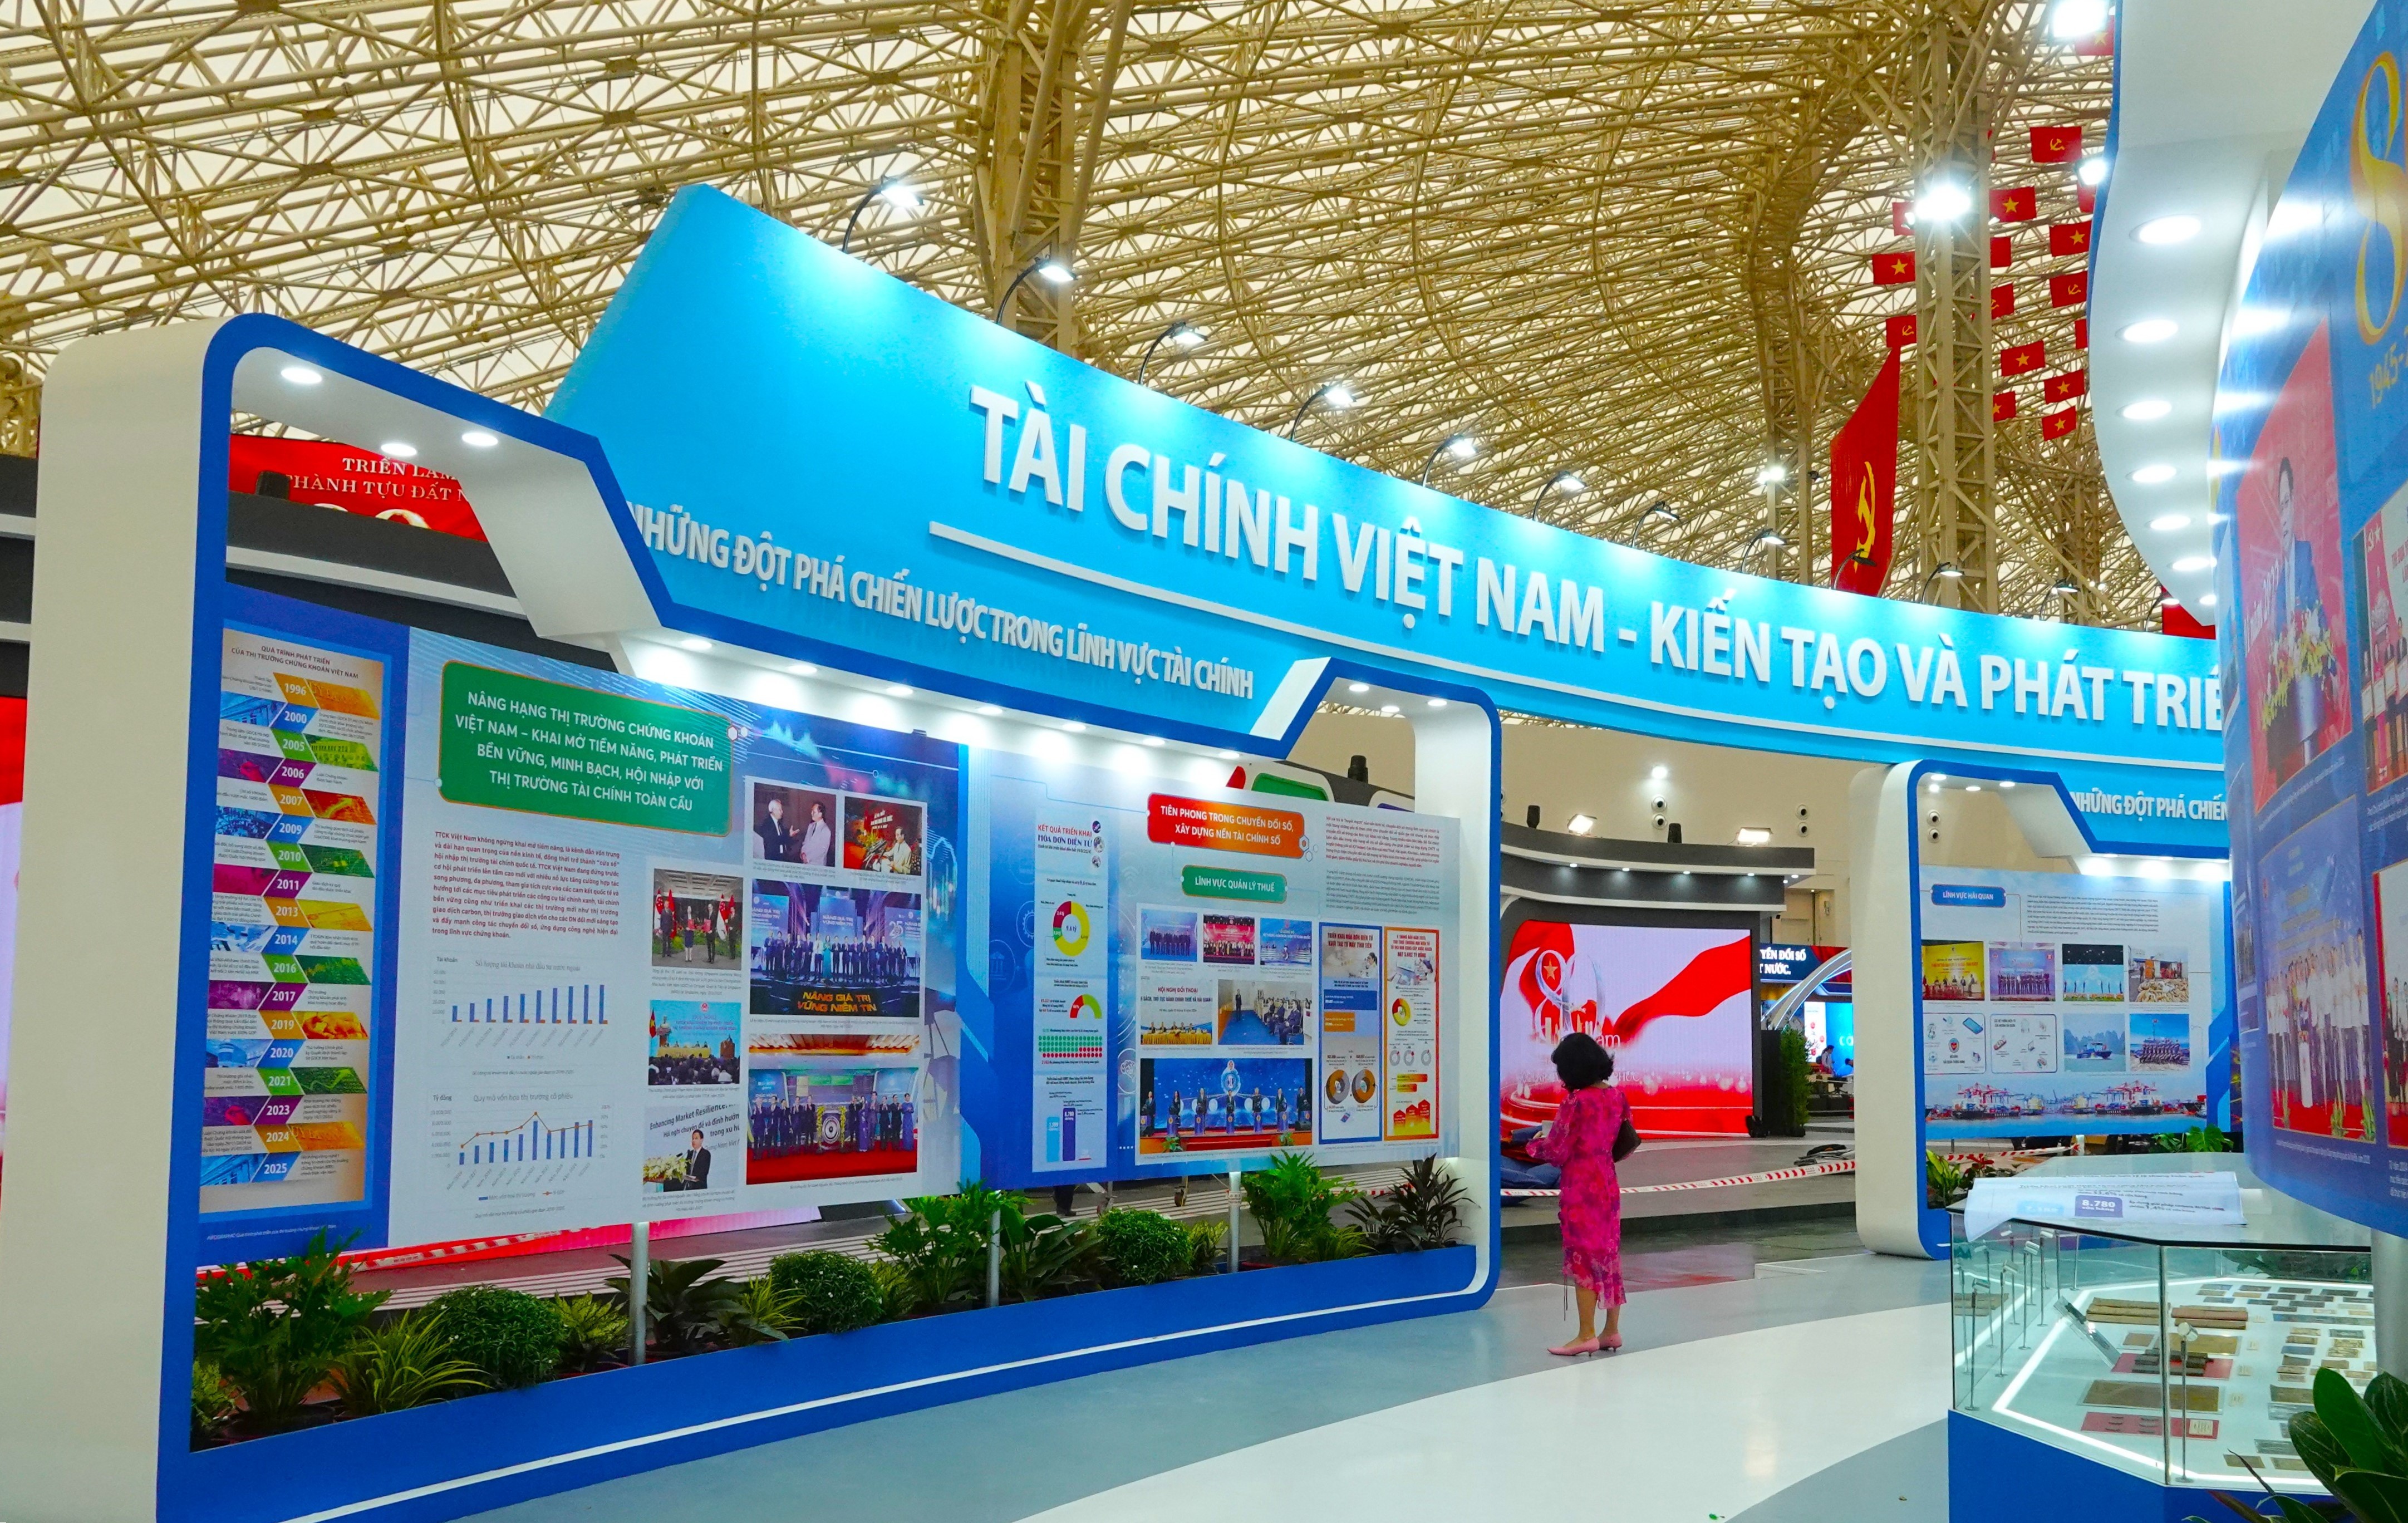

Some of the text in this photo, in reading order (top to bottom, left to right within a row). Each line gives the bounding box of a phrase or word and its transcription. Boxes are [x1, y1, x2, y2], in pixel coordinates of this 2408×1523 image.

[286, 474, 356, 493] HÀNH
[363, 481, 406, 499] TỰU
[411, 482, 451, 501] ĐẤT
[970, 380, 1086, 512] TÀI
[1105, 444, 1318, 582] CHÍNH
[1332, 516, 1463, 629] VIỆT
[1476, 557, 1604, 652] NAM
[1618, 628, 1637, 642] -
[1650, 588, 1770, 682] KIẾN
[1781, 627, 1886, 709] TẠO
[1895, 632, 1968, 708] VÀ
[1981, 648, 2114, 721] PHÁT
[733, 531, 791, 592] ĐỘT
[793, 555, 845, 602] PHÁ
[850, 568, 922, 622] CHIẾN
[925, 591, 989, 644] LƯỢC
[989, 608, 1063, 657] TRONG
[1066, 622, 1114, 669] LĨNH
[1115, 642, 1159, 685] VỰC
[1161, 646, 1191, 686] TÀI
[1194, 657, 1253, 699] CHÍNH
[284, 683, 306, 696] 1996
[284, 711, 307, 724] 2000
[468, 690, 714, 748] NÂNG HẠNG THỊ TRƯỜNG CHỨNG KHOÁN
[283, 739, 304, 751] 2005
[455, 714, 484, 734] VIỆT
[488, 720, 517, 738] NAM
[532, 729, 561, 745] KHAI
[565, 734, 586, 749] MỞ
[589, 738, 616, 754] TIỀM
[620, 743, 657, 763] NĂNG,
[660, 751, 689, 766] PHÁT
[691, 756, 723, 772] TRIỂN
[478, 741, 704, 790] BỀN VỮNG, MINH BẠCH, HỘI NHẬP VỚI
[282, 766, 304, 779] 2006
[490, 770, 510, 789] THỊ
[514, 775, 568, 793] TRƯỜNG
[572, 780, 589, 797] TÀI
[593, 785, 631, 803] CHÍNH
[635, 791, 666, 807] TOÀN
[279, 794, 302, 806] 2007
[2124, 791, 2154, 822] ĐỘT
[2156, 793, 2186, 818] PHÁ
[1161, 804, 1177, 816] TIÊN
[1180, 810, 1207, 821] PHONG
[1209, 813, 1235, 824] TRONG
[1236, 817, 1265, 827] CHUYỂN
[1268, 818, 1280, 829] ĐỔI
[279, 822, 302, 834] 2009
[1175, 823, 1280, 845] XÂY DỰNG NỀN TÀI CHÍNH SỐ
[278, 850, 301, 862] 2010
[277, 878, 299, 891] 2011
[1195, 876, 1275, 892] LĨNH VỰC QUẢN LÝ THUẾ
[276, 906, 298, 917] 2013
[274, 934, 297, 945] 2014
[273, 962, 296, 974] 2016
[272, 991, 295, 1001] 2017
[271, 1020, 294, 1030] 2019
[271, 1048, 294, 1058] 2020
[269, 1076, 291, 1087] 2021
[267, 1104, 290, 1116] 2023
[650, 1117, 674, 1130] Enhancing
[676, 1111, 694, 1122] Market
[266, 1132, 289, 1142] 2024
[264, 1163, 287, 1174] 2025
